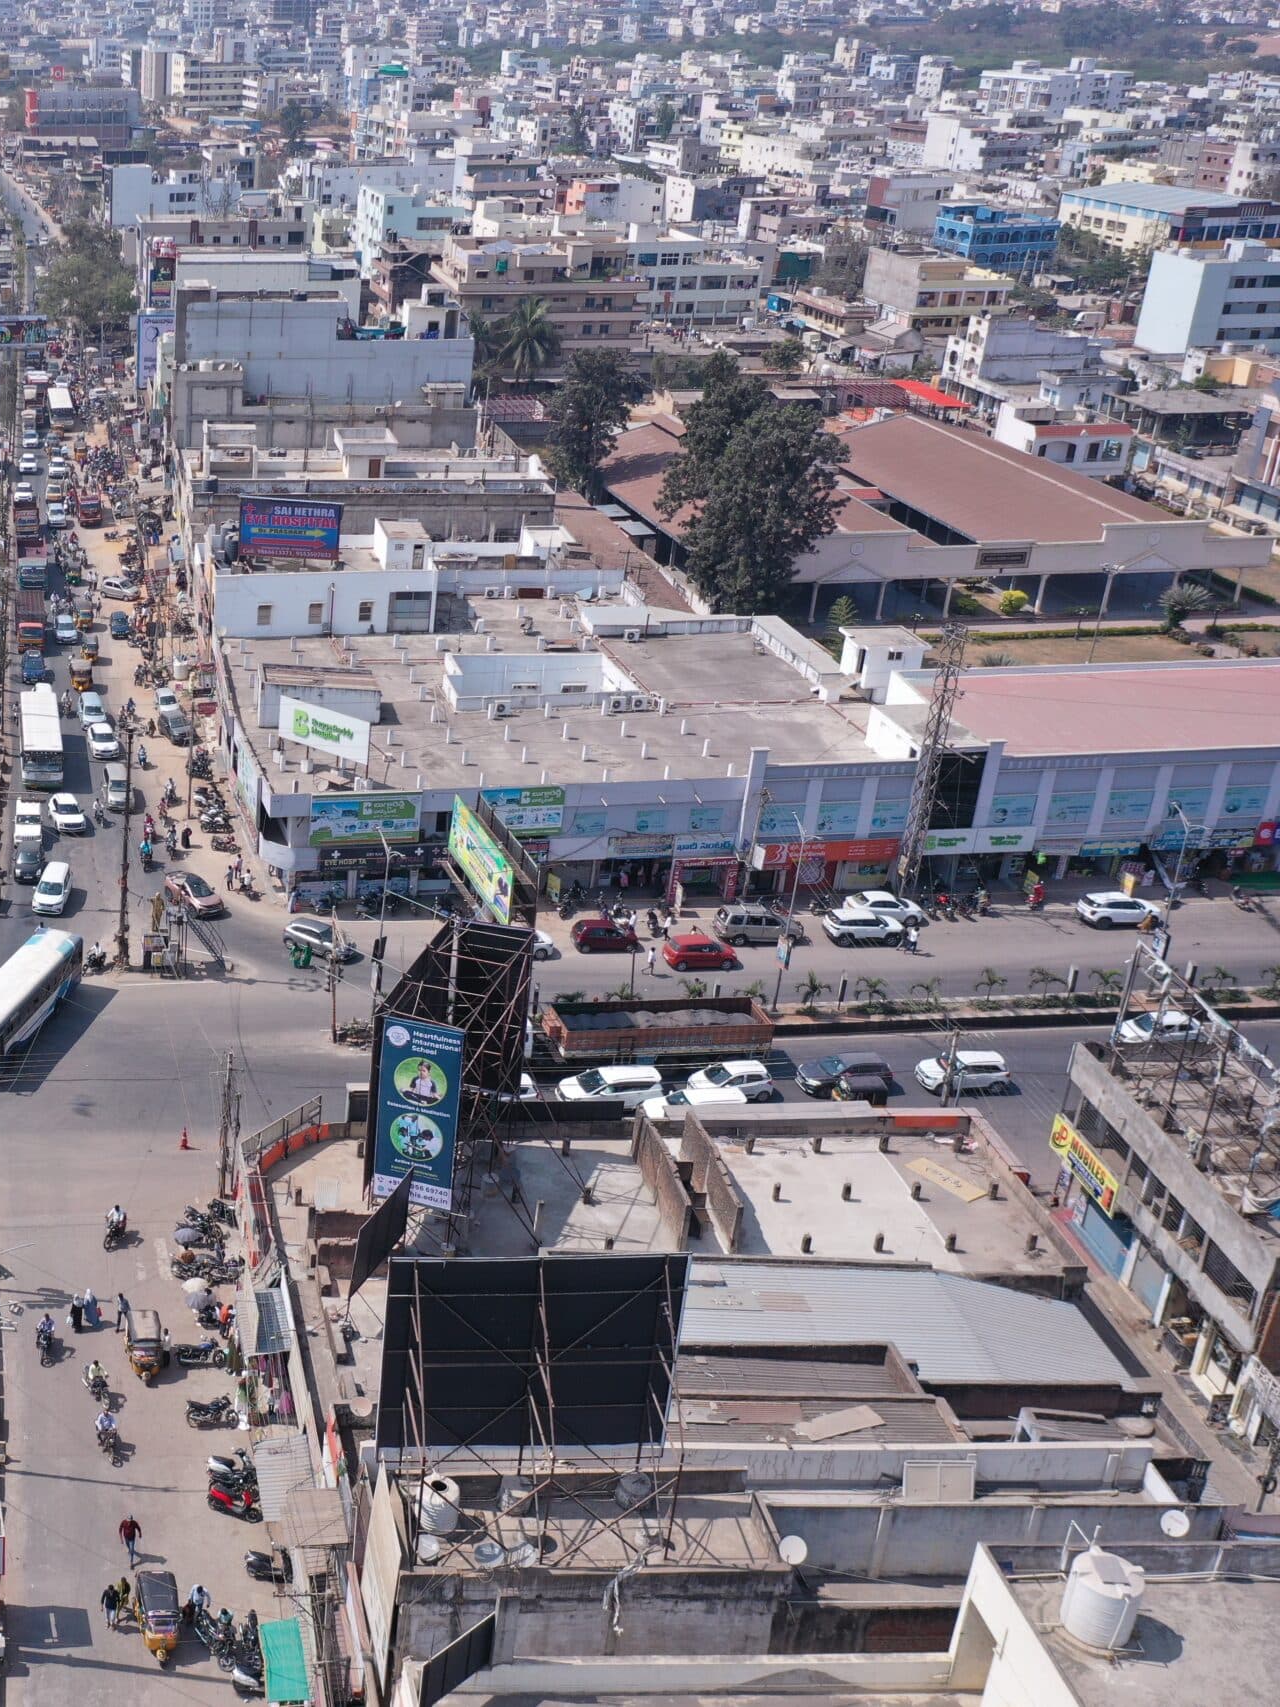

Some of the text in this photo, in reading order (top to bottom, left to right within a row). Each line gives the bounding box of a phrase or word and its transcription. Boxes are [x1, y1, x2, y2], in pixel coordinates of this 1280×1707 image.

[274, 506, 335, 517] SAI NETHRA
[245, 514, 338, 529] EYE HOSPITAL
[413, 1030, 461, 1045] Heartfulness
[411, 1045, 438, 1056] School
[412, 1038, 462, 1052] International
[1070, 1136, 1107, 1186] MOBILES
